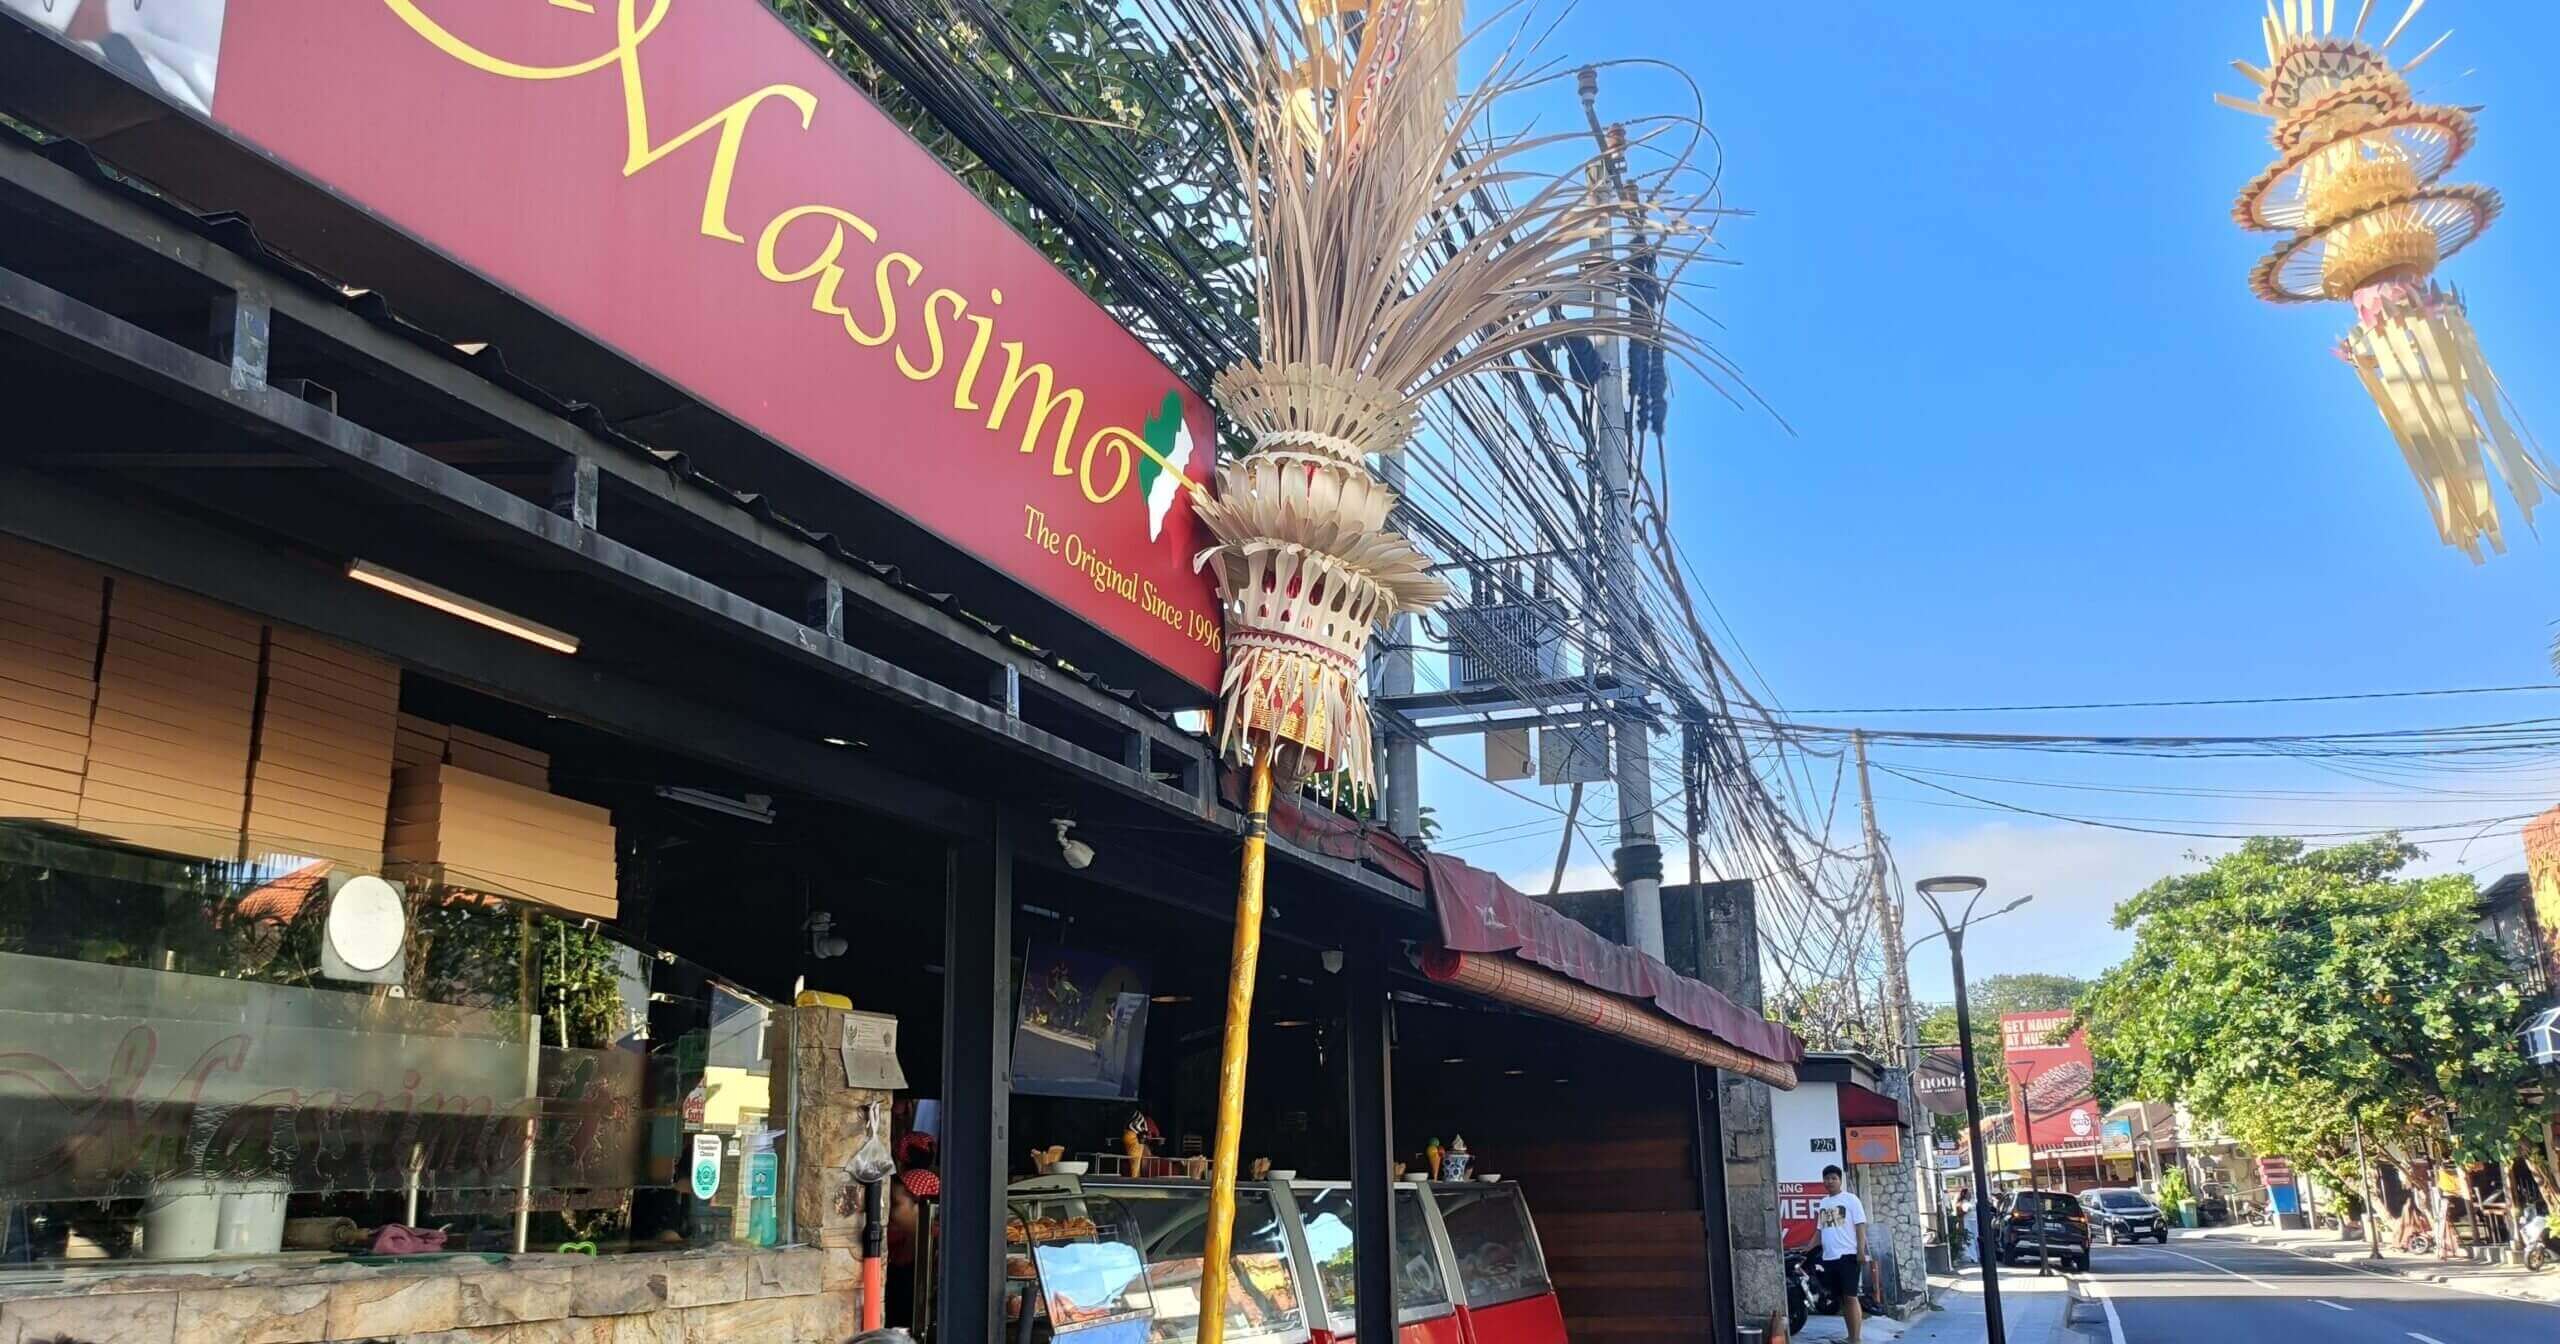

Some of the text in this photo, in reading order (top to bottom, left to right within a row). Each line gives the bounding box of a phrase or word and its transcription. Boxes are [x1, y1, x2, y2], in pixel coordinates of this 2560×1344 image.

[384, 0, 1198, 503] Massimo
[1024, 504, 1221, 654] The Original Since 1996
[1813, 1139, 1834, 1152] 226
